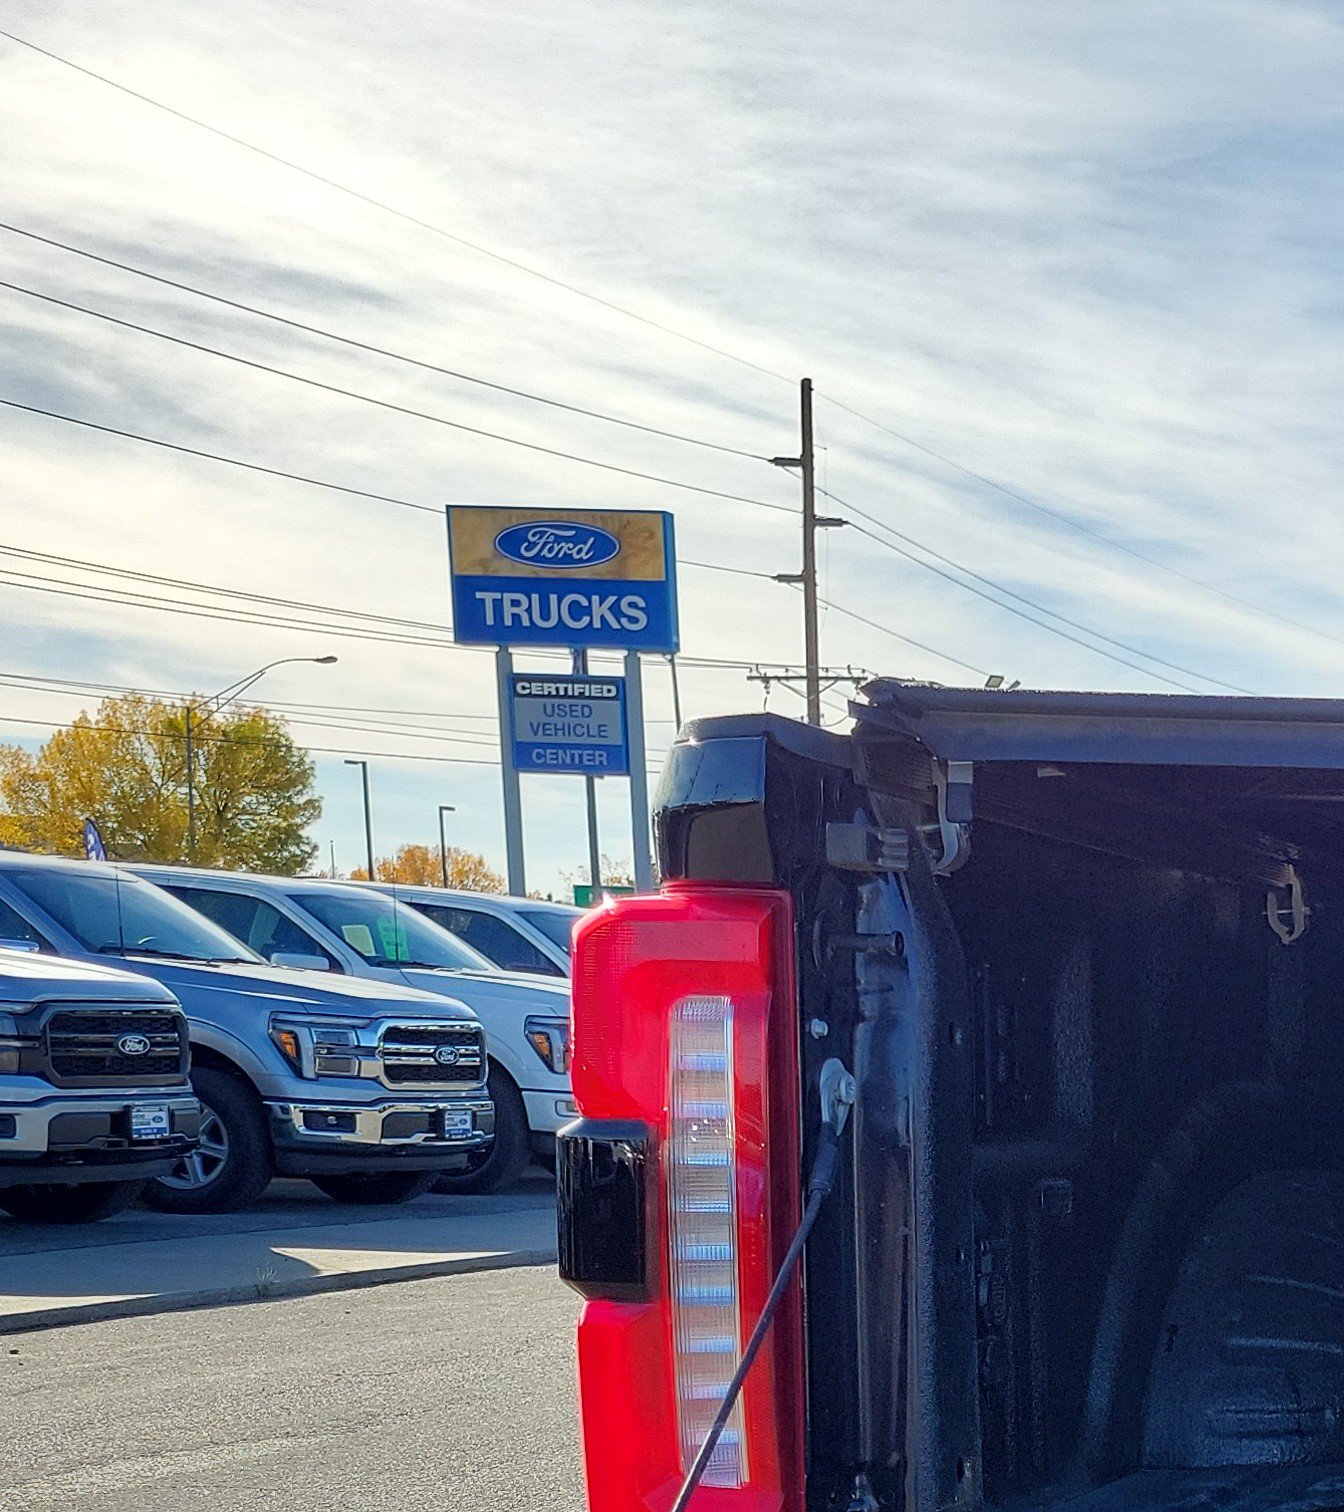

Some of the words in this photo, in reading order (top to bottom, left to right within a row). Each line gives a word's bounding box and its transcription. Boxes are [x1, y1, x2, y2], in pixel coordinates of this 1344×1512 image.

[520, 527, 595, 560] Ford
[475, 591, 648, 631] TRUCKS
[515, 681, 617, 698] CERTIFIED
[543, 703, 593, 719] USED
[529, 721, 609, 739] VEHICLE
[531, 749, 608, 767] CENTER
